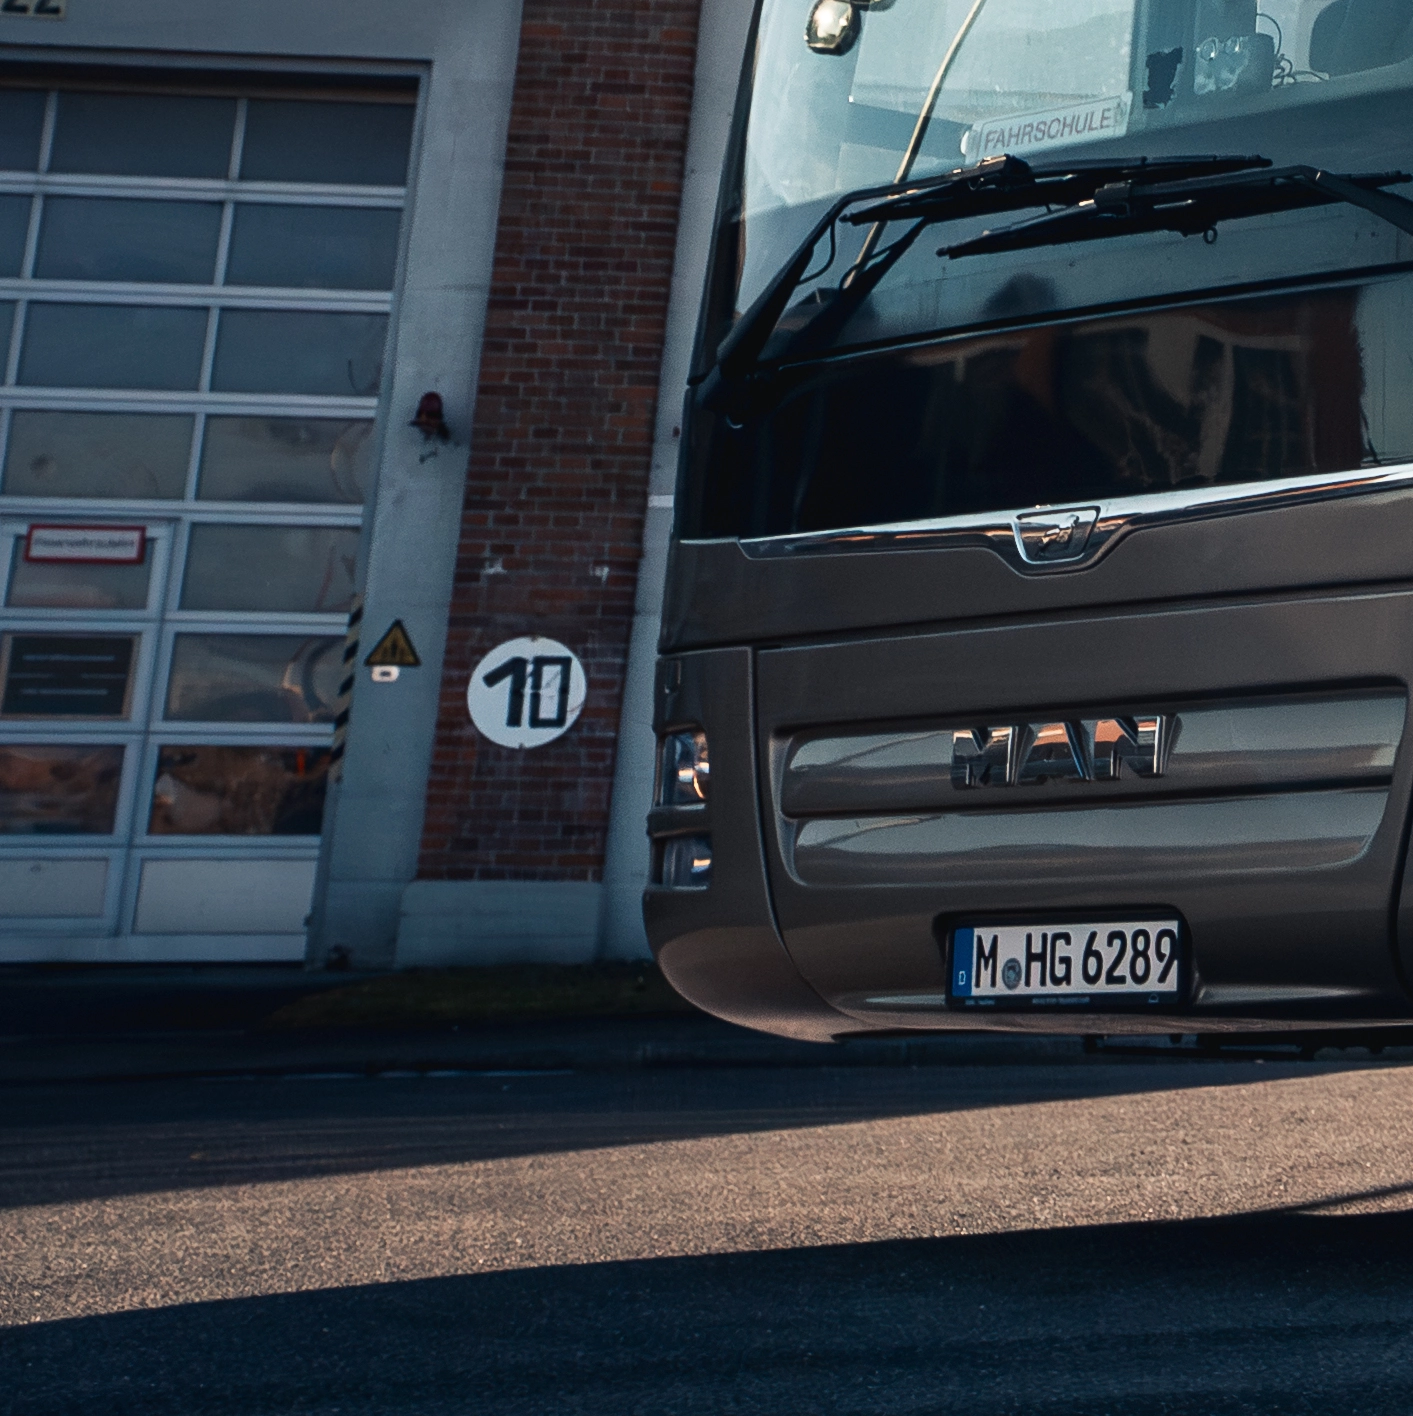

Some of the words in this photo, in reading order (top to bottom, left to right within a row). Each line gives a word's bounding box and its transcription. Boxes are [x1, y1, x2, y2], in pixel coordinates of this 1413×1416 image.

[984, 107, 1112, 150] FAHRSCHULE
[483, 656, 572, 729] 10
[951, 712, 1180, 789] MAN
[958, 971, 967, 985] D
[974, 934, 999, 989] M
[1024, 932, 1072, 987] HG
[1082, 929, 1178, 985] 6289
